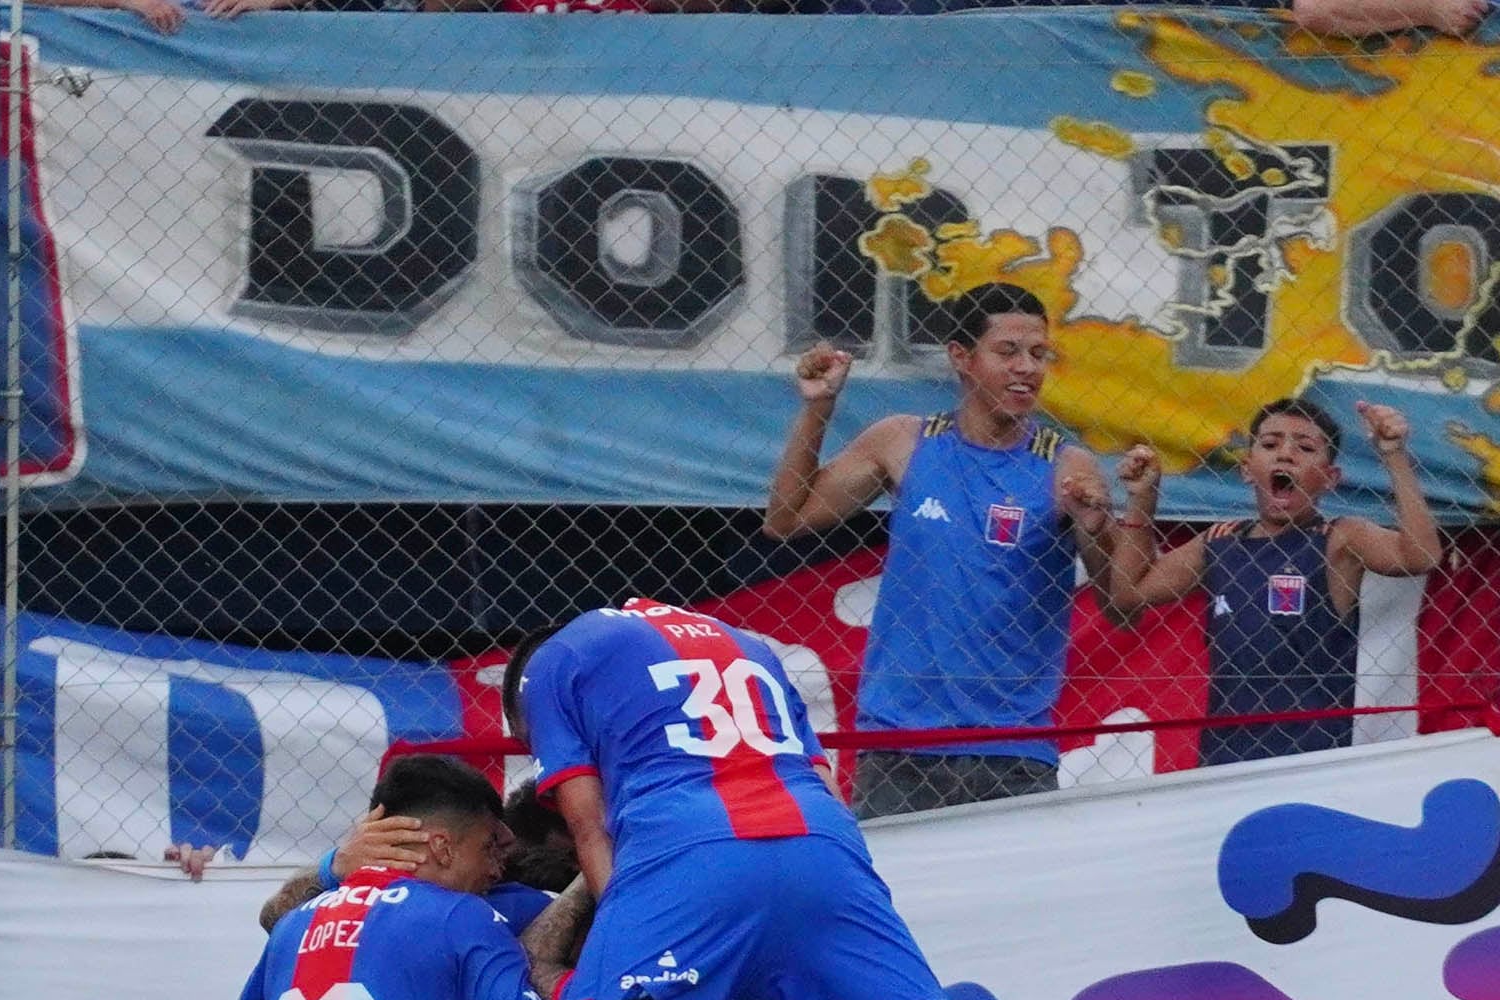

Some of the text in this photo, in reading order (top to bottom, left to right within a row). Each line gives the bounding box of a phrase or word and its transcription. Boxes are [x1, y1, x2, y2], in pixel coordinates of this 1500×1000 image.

[664, 623, 722, 639] PAZ
[647, 658, 804, 758] 30
[297, 919, 365, 954] LOPEZ
